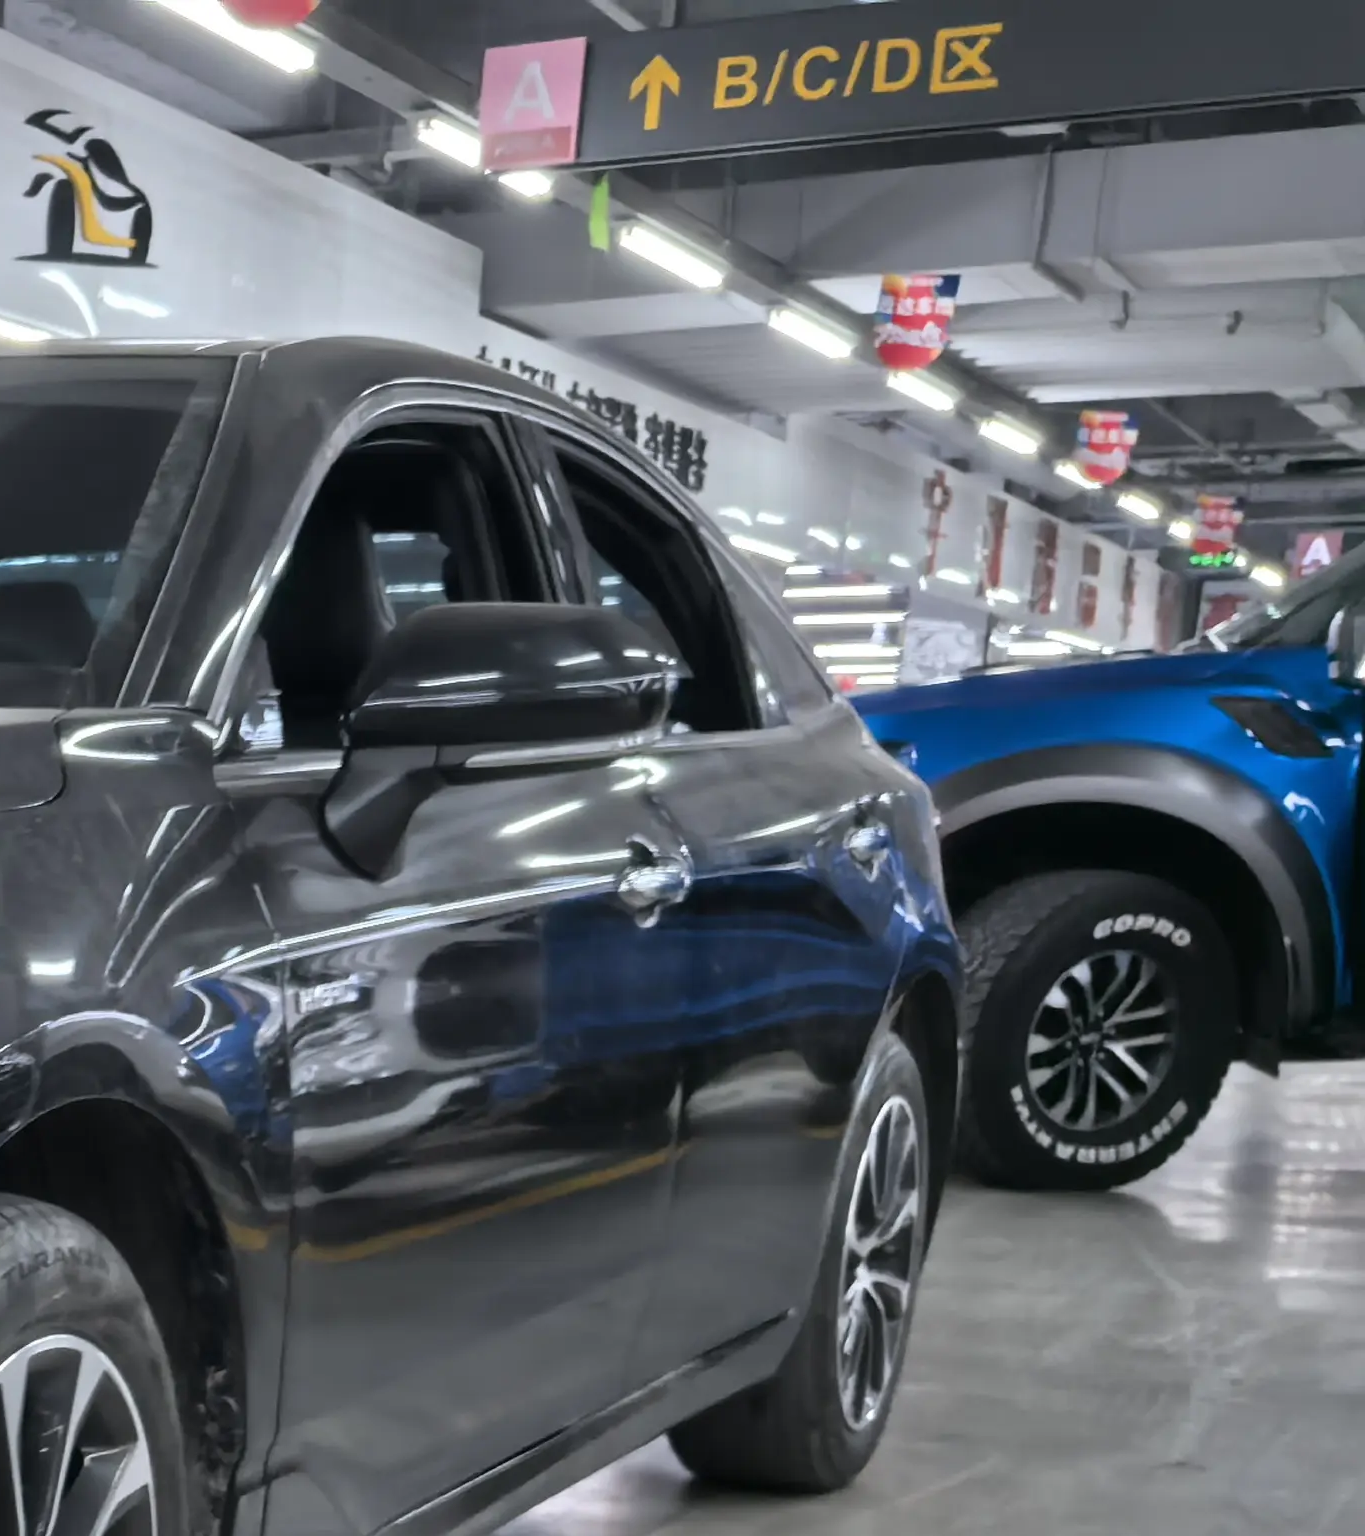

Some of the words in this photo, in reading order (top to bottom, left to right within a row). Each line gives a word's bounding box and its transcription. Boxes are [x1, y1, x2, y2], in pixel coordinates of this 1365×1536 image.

[502, 60, 556, 125] A
[713, 23, 1003, 110] B/C/D区
[1302, 536, 1332, 566] A
